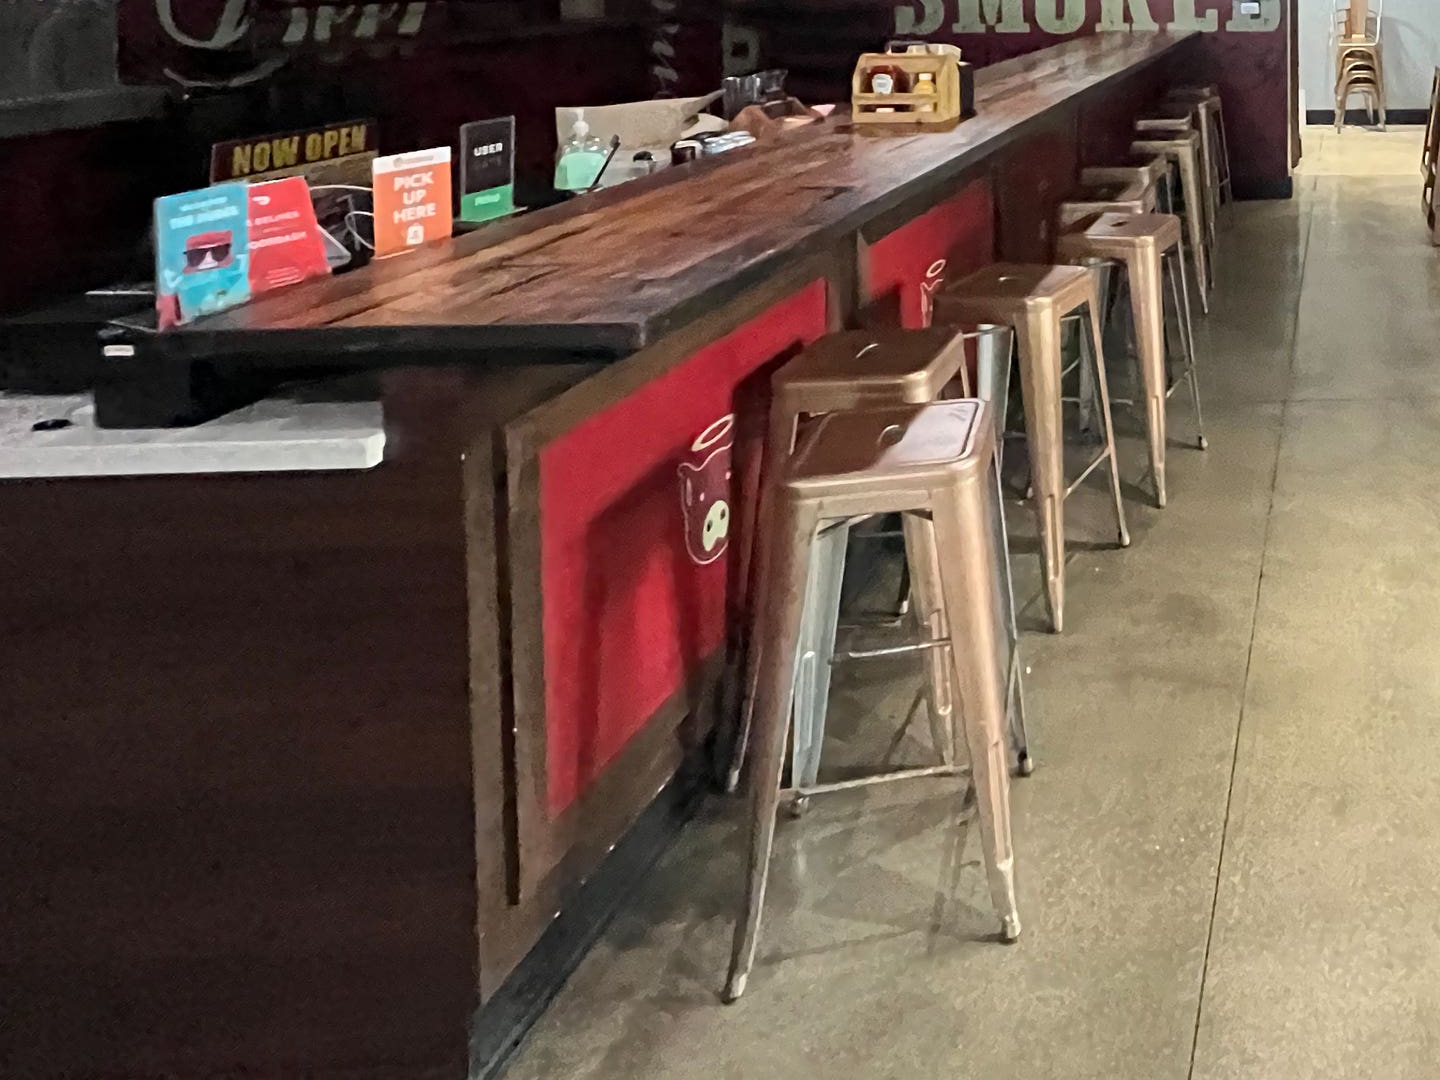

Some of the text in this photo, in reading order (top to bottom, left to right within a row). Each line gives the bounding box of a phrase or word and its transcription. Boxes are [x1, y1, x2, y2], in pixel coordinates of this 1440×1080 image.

[231, 123, 367, 177] NOW OPEN
[473, 142, 503, 156] UBER
[393, 171, 434, 191] PICK
[402, 189, 427, 206] UP
[393, 202, 437, 225] HERE
